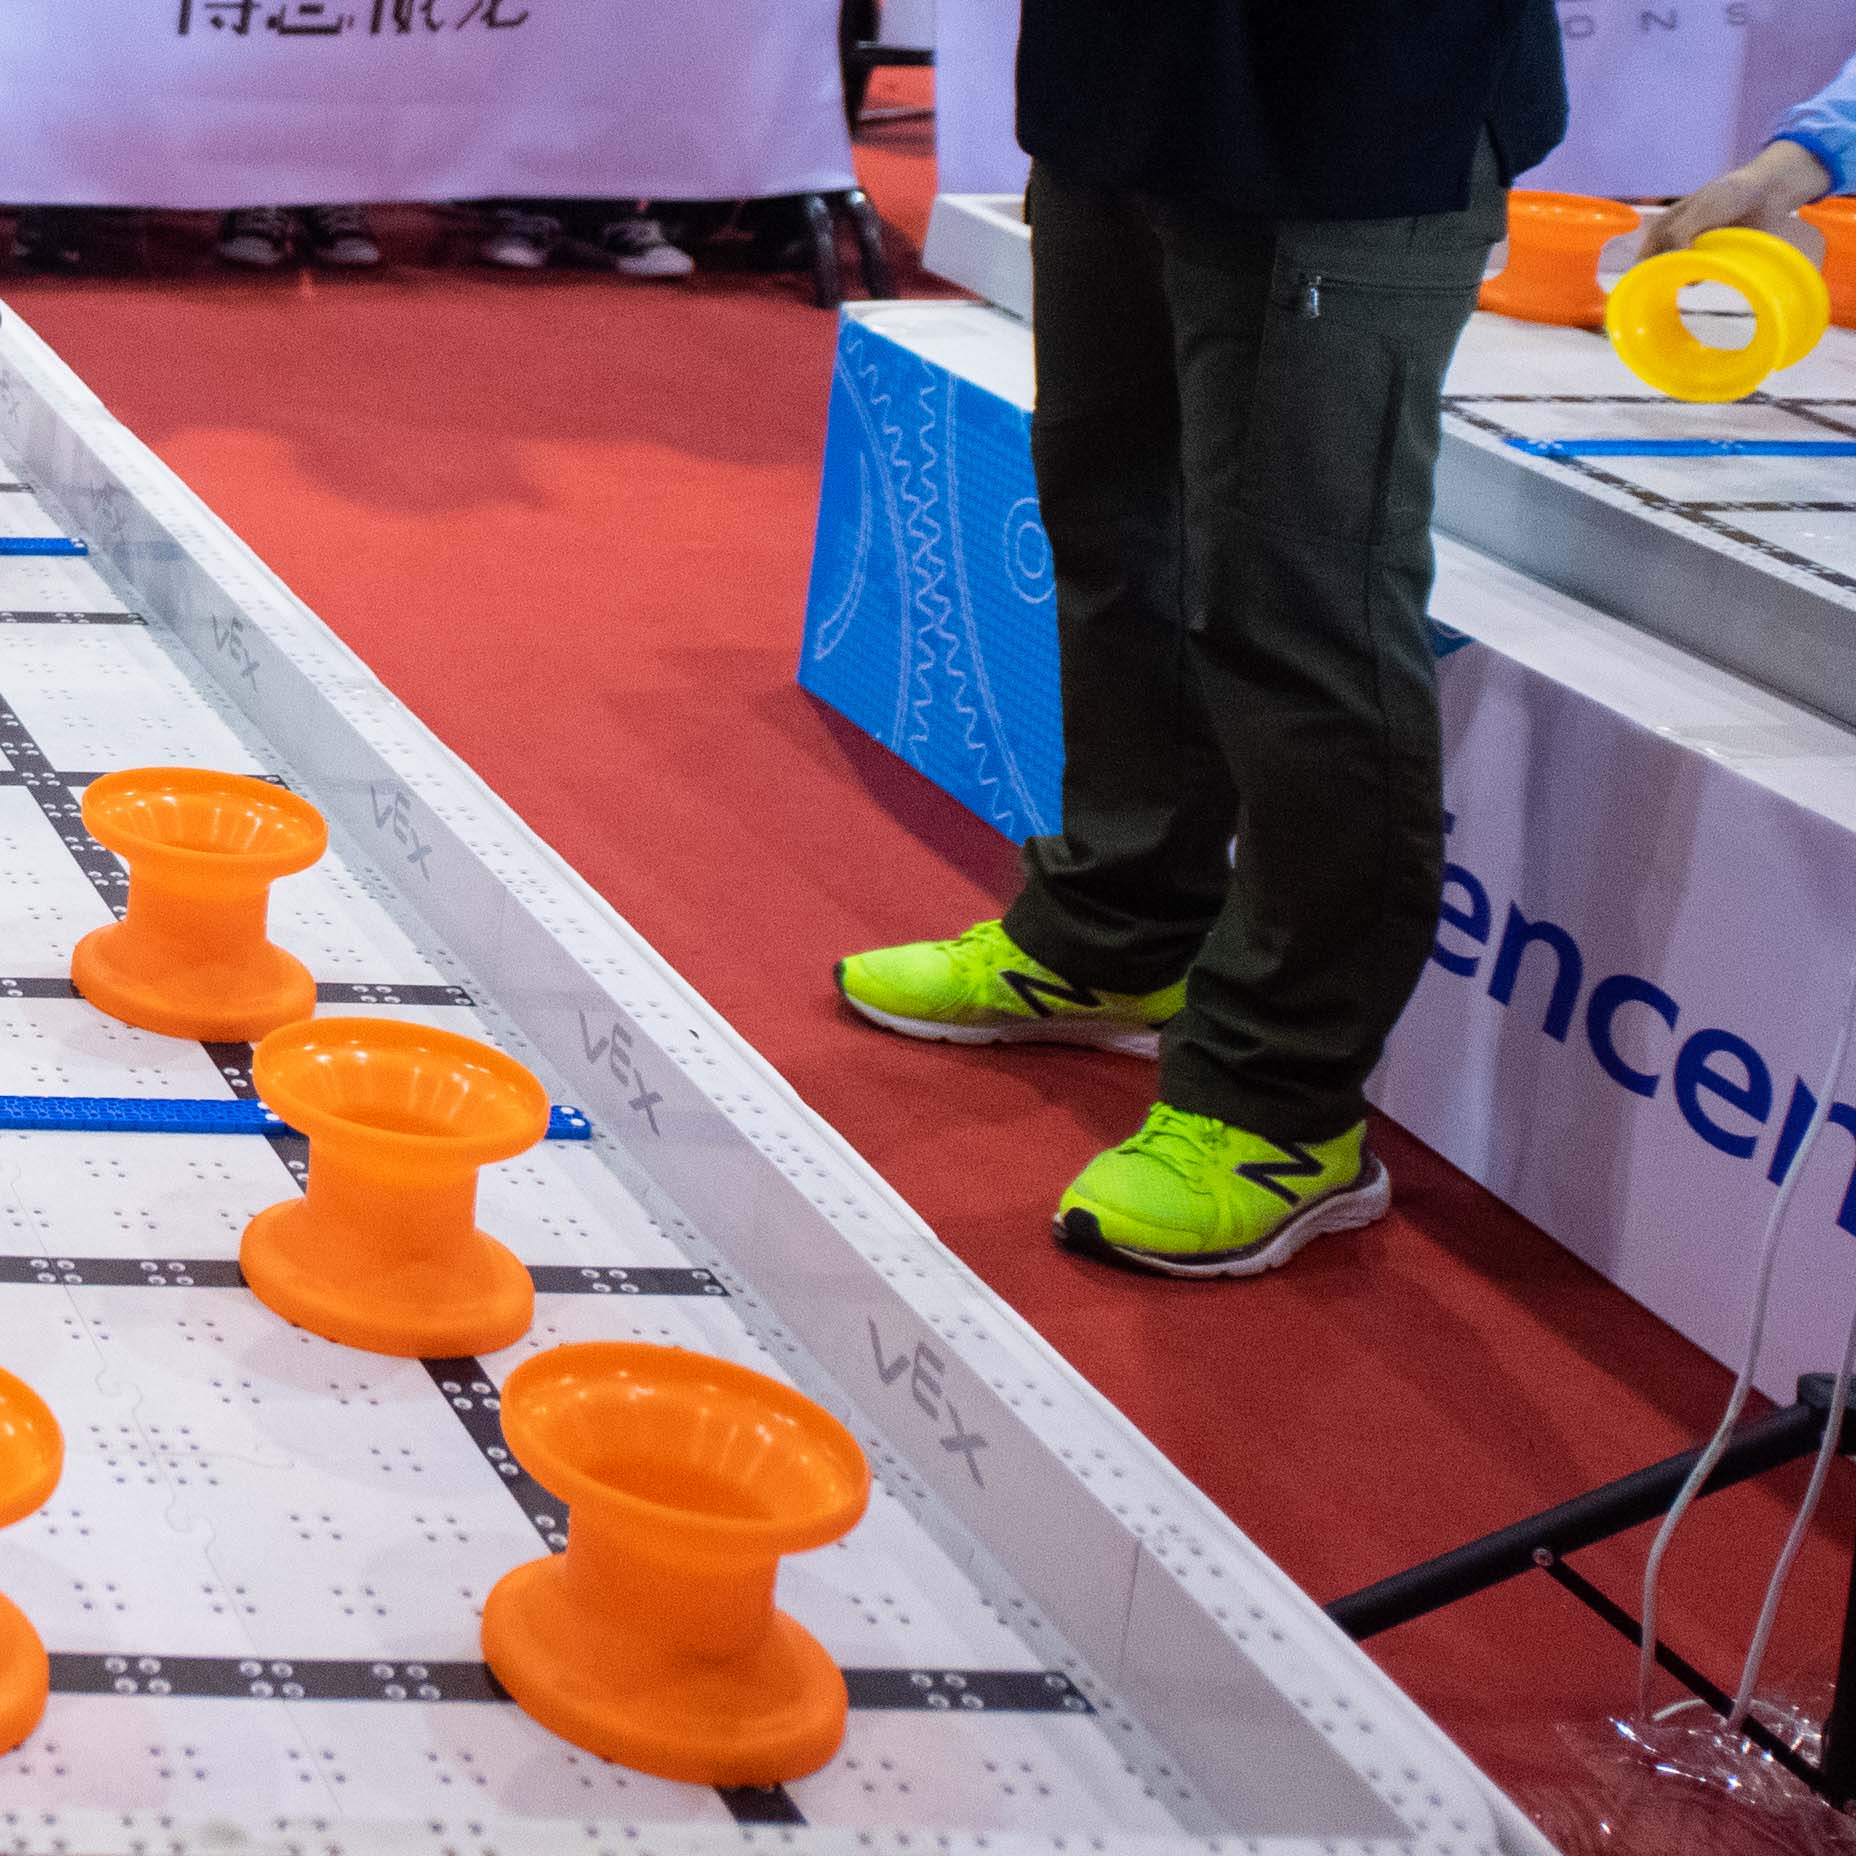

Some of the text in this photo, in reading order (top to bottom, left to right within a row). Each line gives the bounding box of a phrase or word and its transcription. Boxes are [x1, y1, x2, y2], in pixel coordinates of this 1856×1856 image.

[370, 784, 434, 881] VEX
[578, 1008, 664, 1138] VEX
[1430, 858, 1856, 1239] encen
[866, 1315, 989, 1490] VEX
